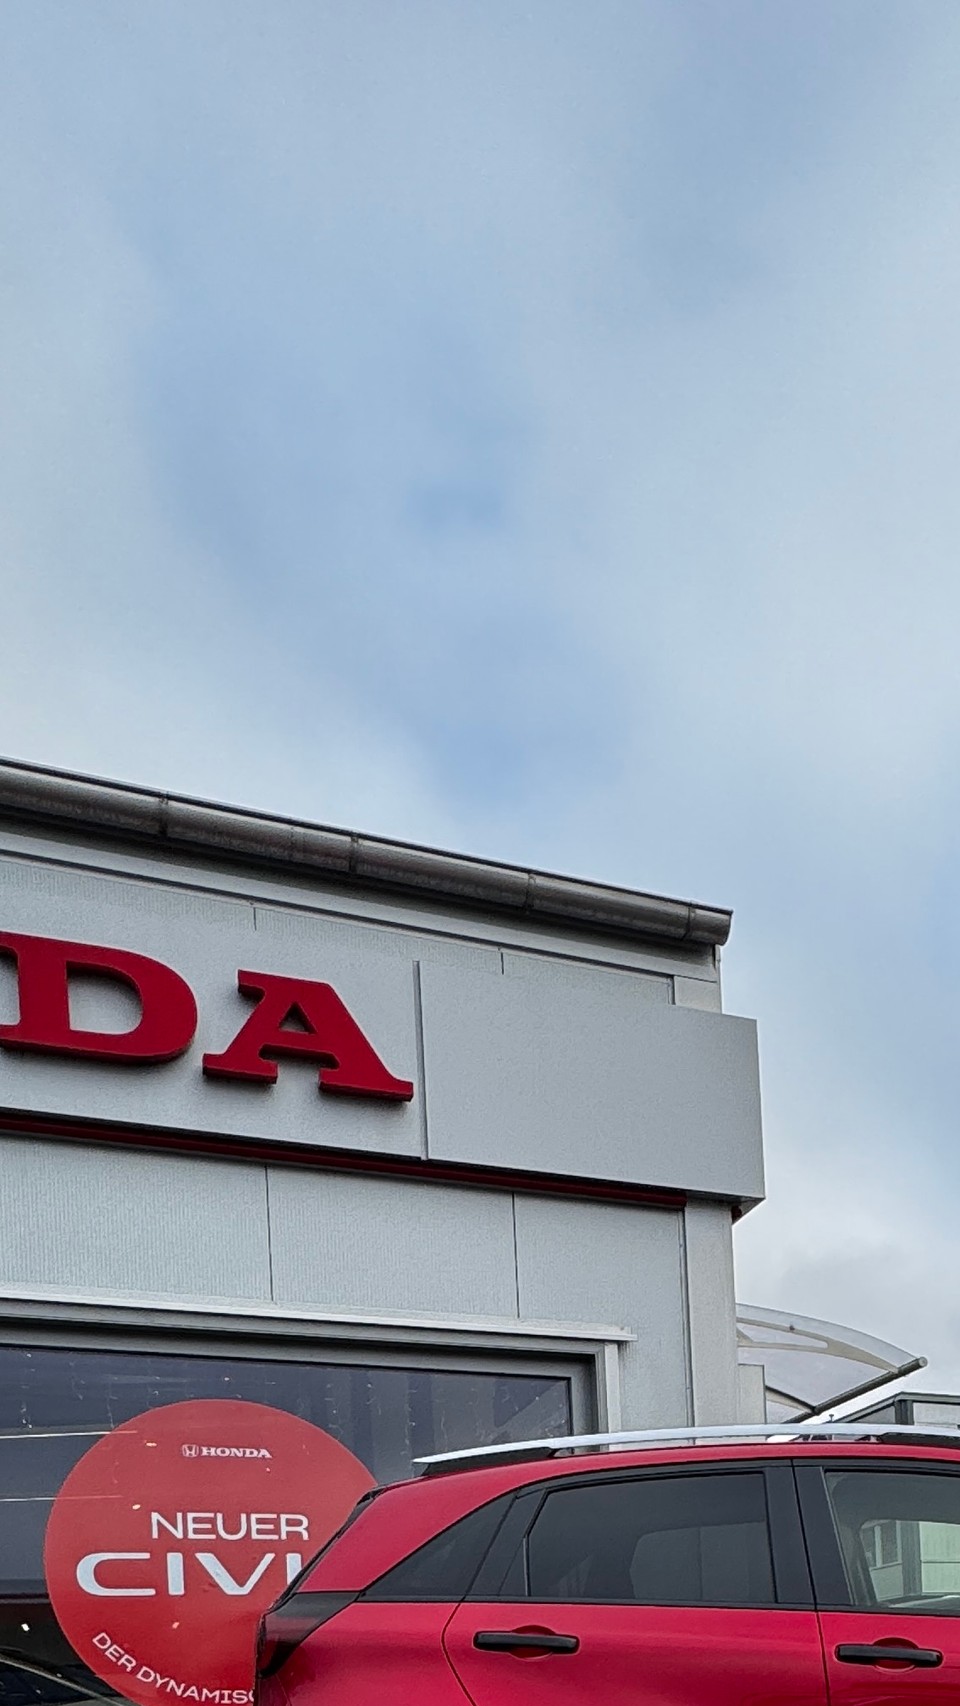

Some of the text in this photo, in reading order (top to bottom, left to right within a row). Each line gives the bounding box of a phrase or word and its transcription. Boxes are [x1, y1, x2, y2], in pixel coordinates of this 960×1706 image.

[0, 930, 414, 1102] DA
[200, 1446, 273, 1459] HONDA
[150, 1511, 310, 1541] NEUER
[92, 1632, 137, 1673] DER
